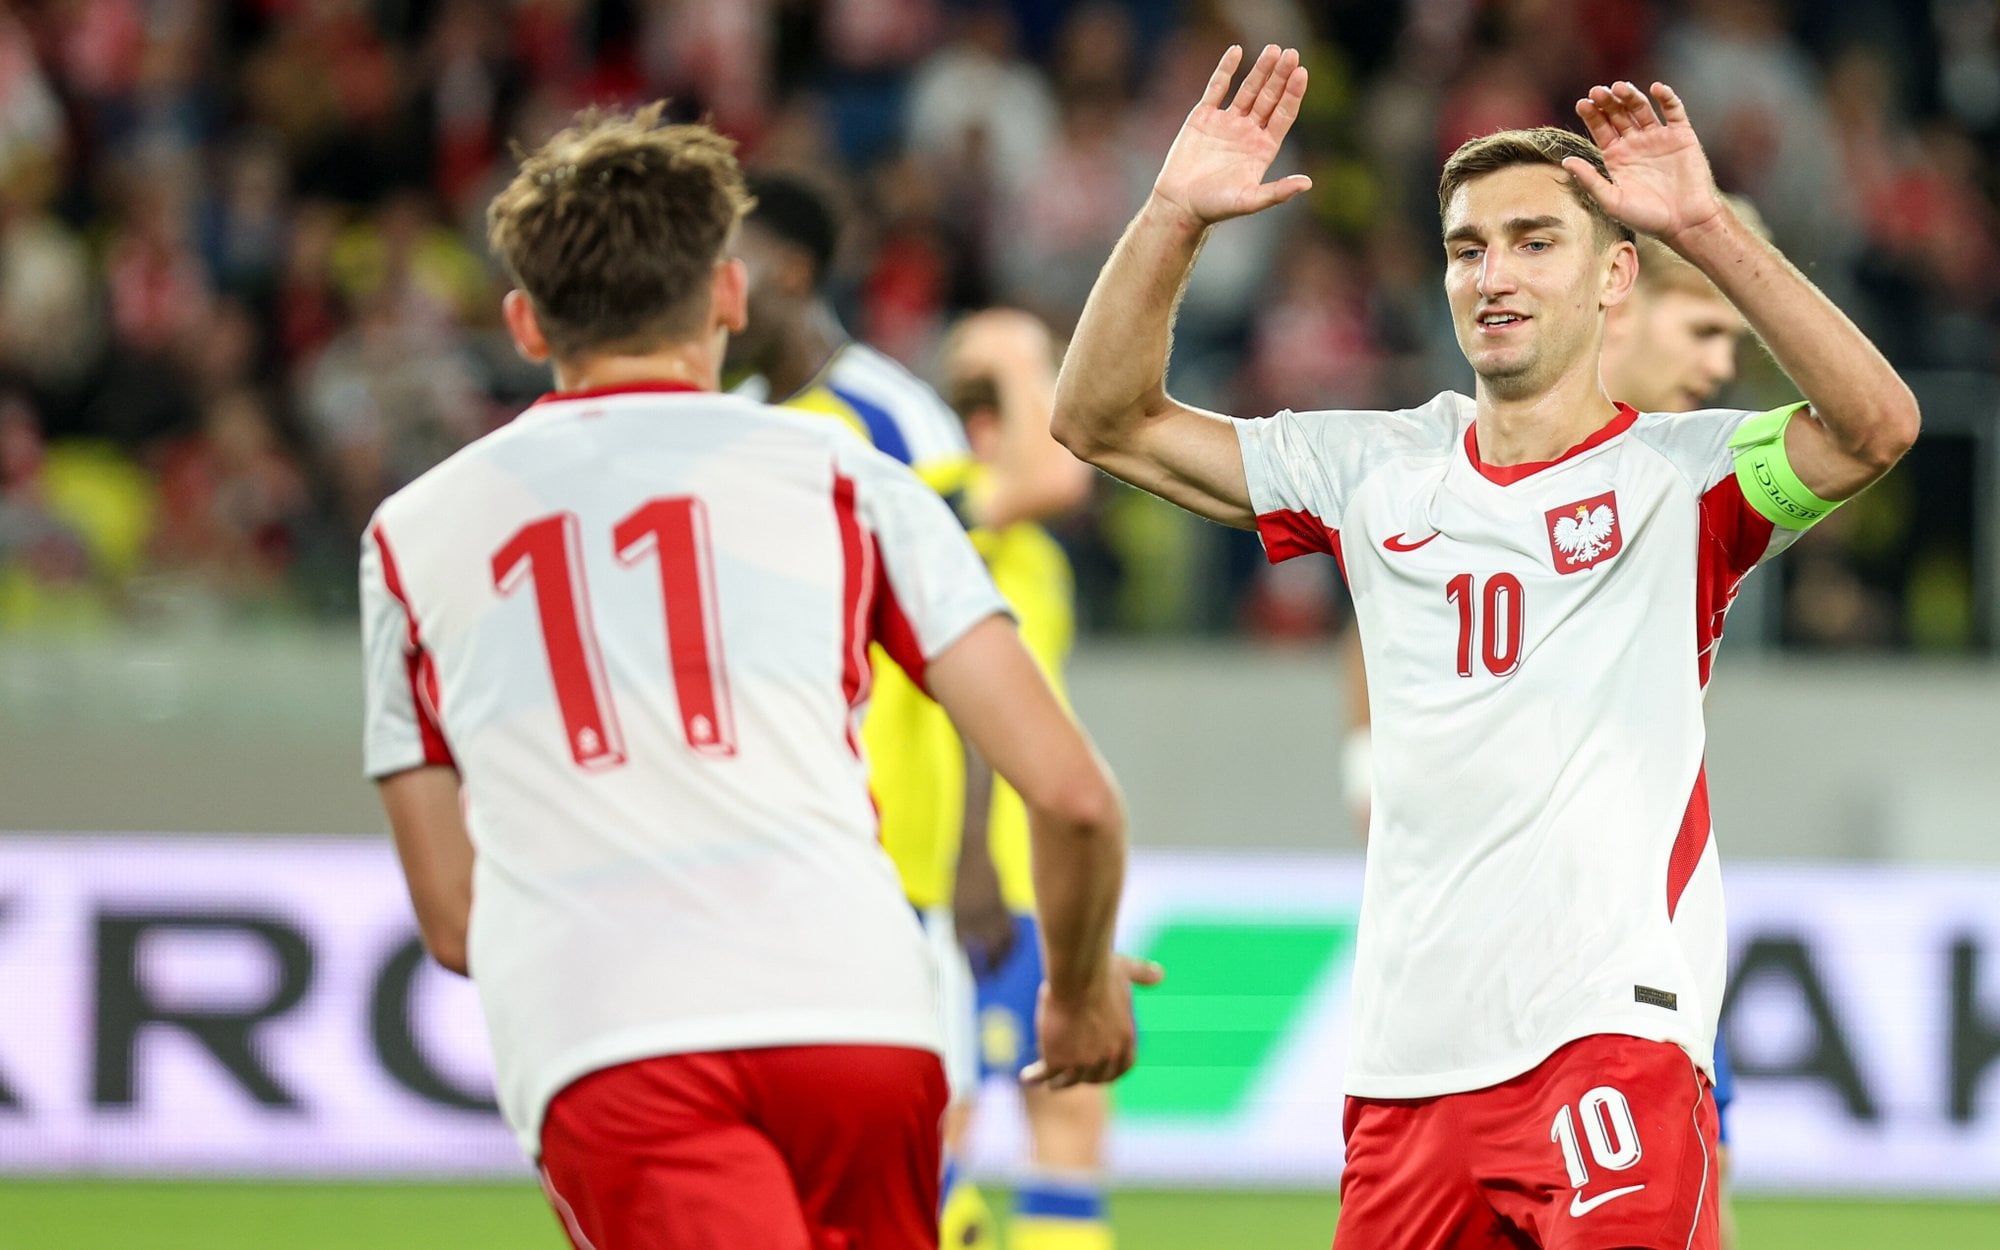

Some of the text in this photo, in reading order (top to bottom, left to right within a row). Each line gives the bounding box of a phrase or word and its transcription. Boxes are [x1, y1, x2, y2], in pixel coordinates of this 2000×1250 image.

[1755, 461, 1822, 519] RESPECT
[490, 494, 737, 769] 11
[1446, 572, 1525, 677] 10
[1550, 1086, 1643, 1189] 10
